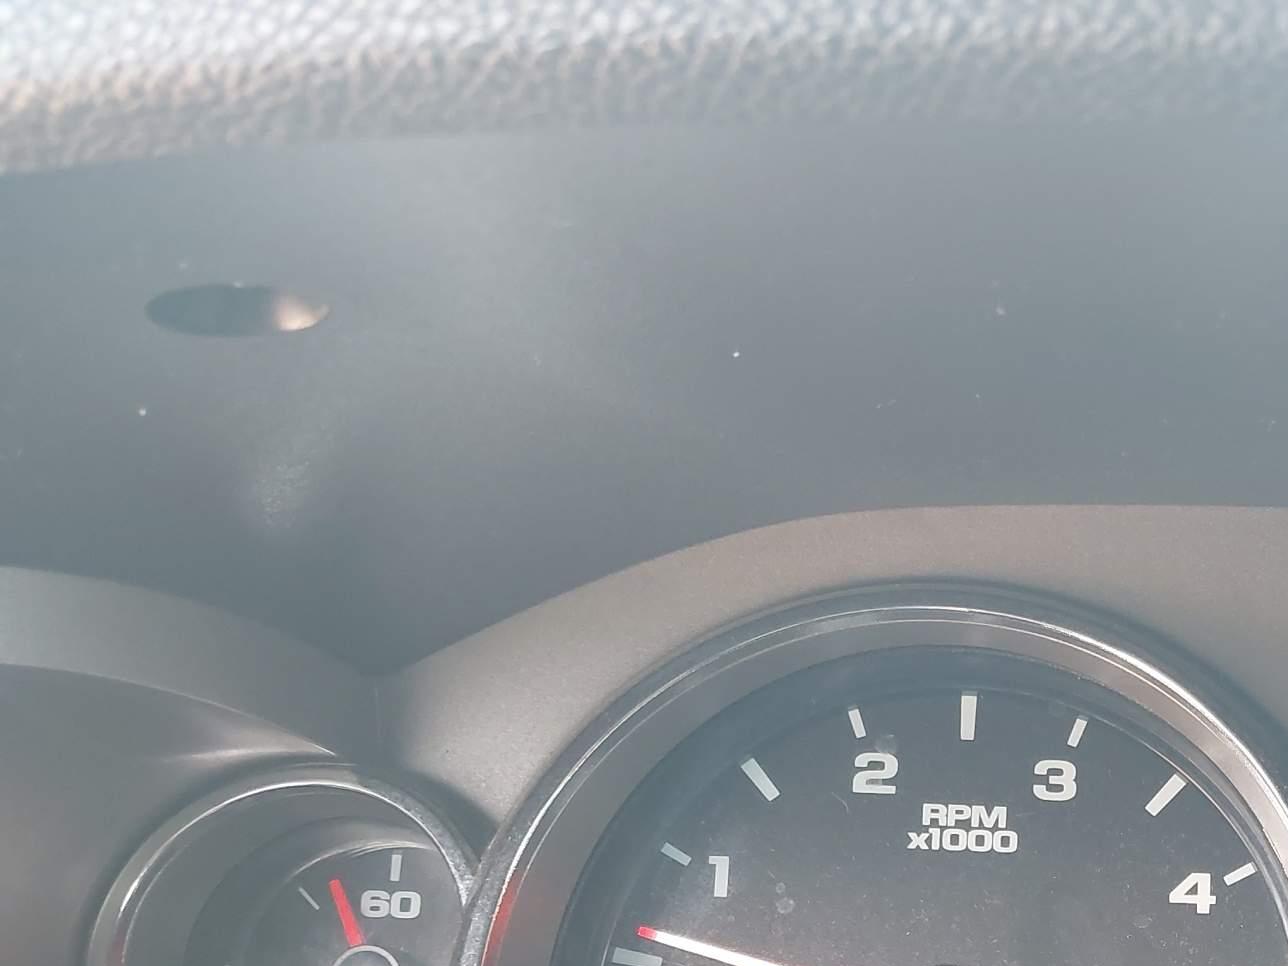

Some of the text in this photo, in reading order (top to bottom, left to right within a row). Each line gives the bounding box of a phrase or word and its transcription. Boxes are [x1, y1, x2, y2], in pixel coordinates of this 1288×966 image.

[852, 754, 898, 795] 2
[1033, 760, 1078, 800] 3
[922, 803, 1008, 828] RPM
[907, 828, 1018, 852] x1000
[708, 855, 729, 897] 1
[1169, 872, 1217, 913] 4
[360, 889, 422, 918] 60
